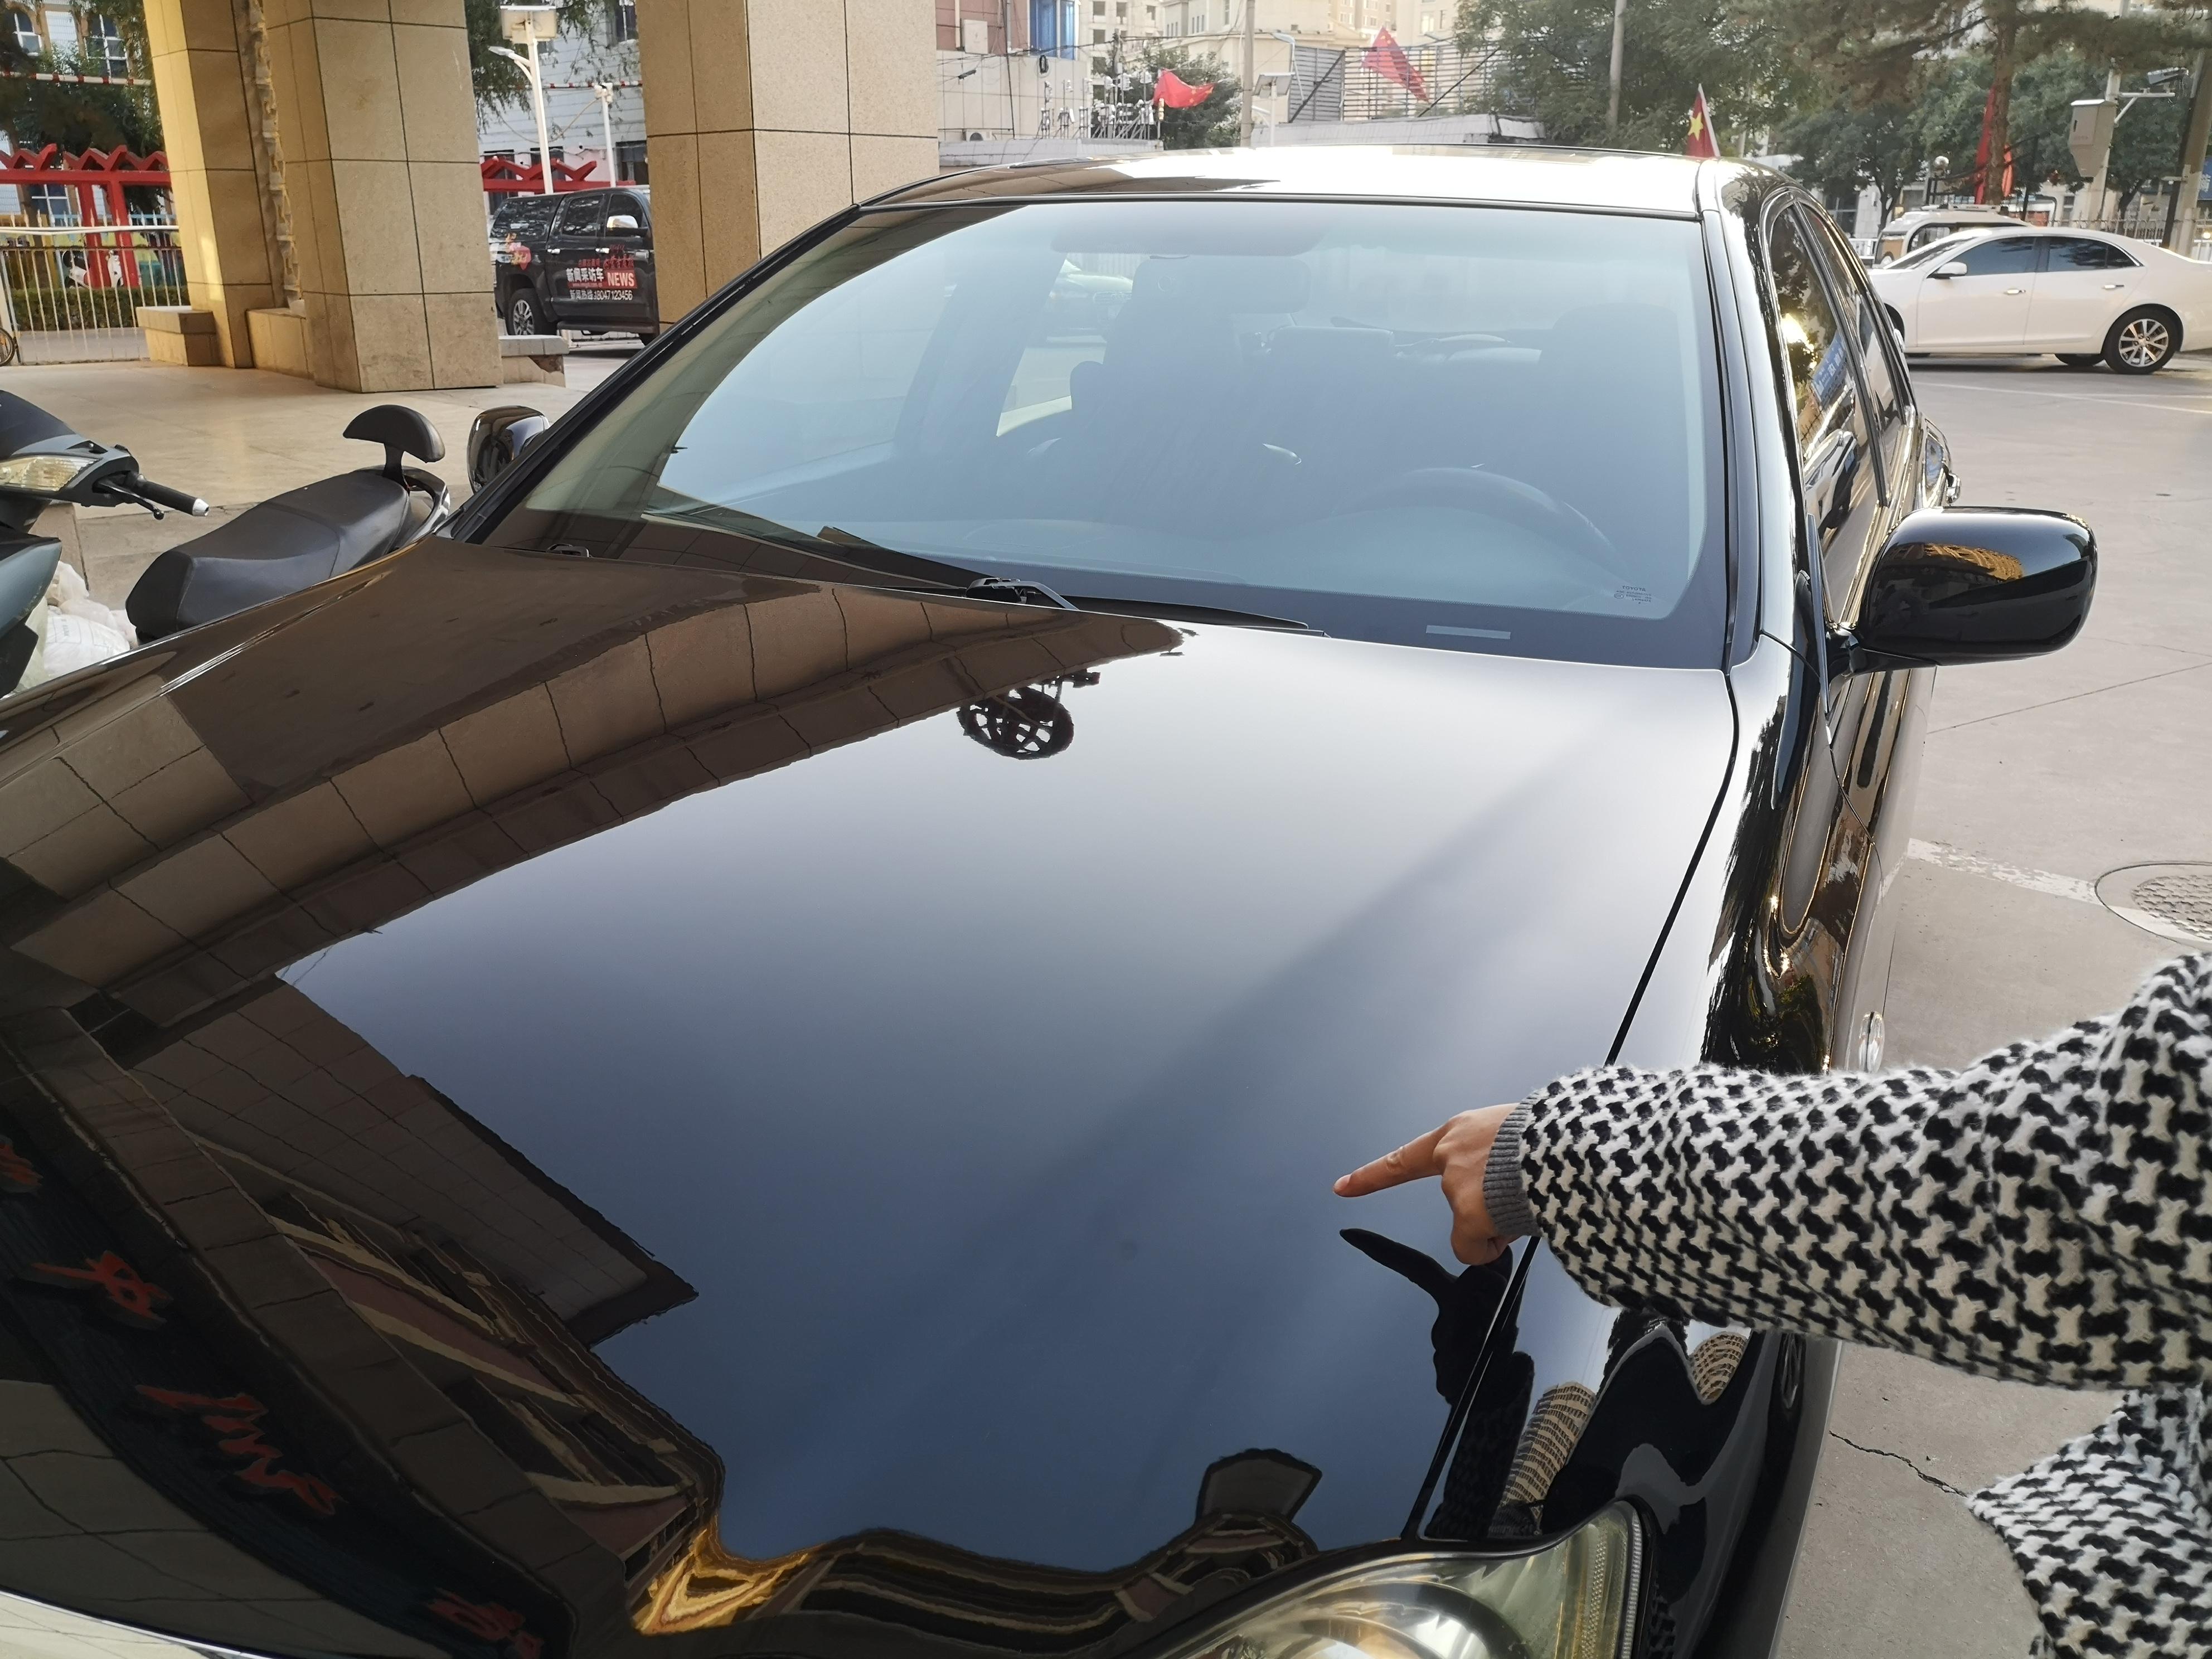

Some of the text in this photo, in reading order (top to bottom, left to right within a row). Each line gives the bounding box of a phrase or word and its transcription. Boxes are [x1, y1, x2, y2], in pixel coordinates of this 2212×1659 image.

[566, 268, 604, 282] 新闻采访车
[607, 273, 634, 287] NEWS
